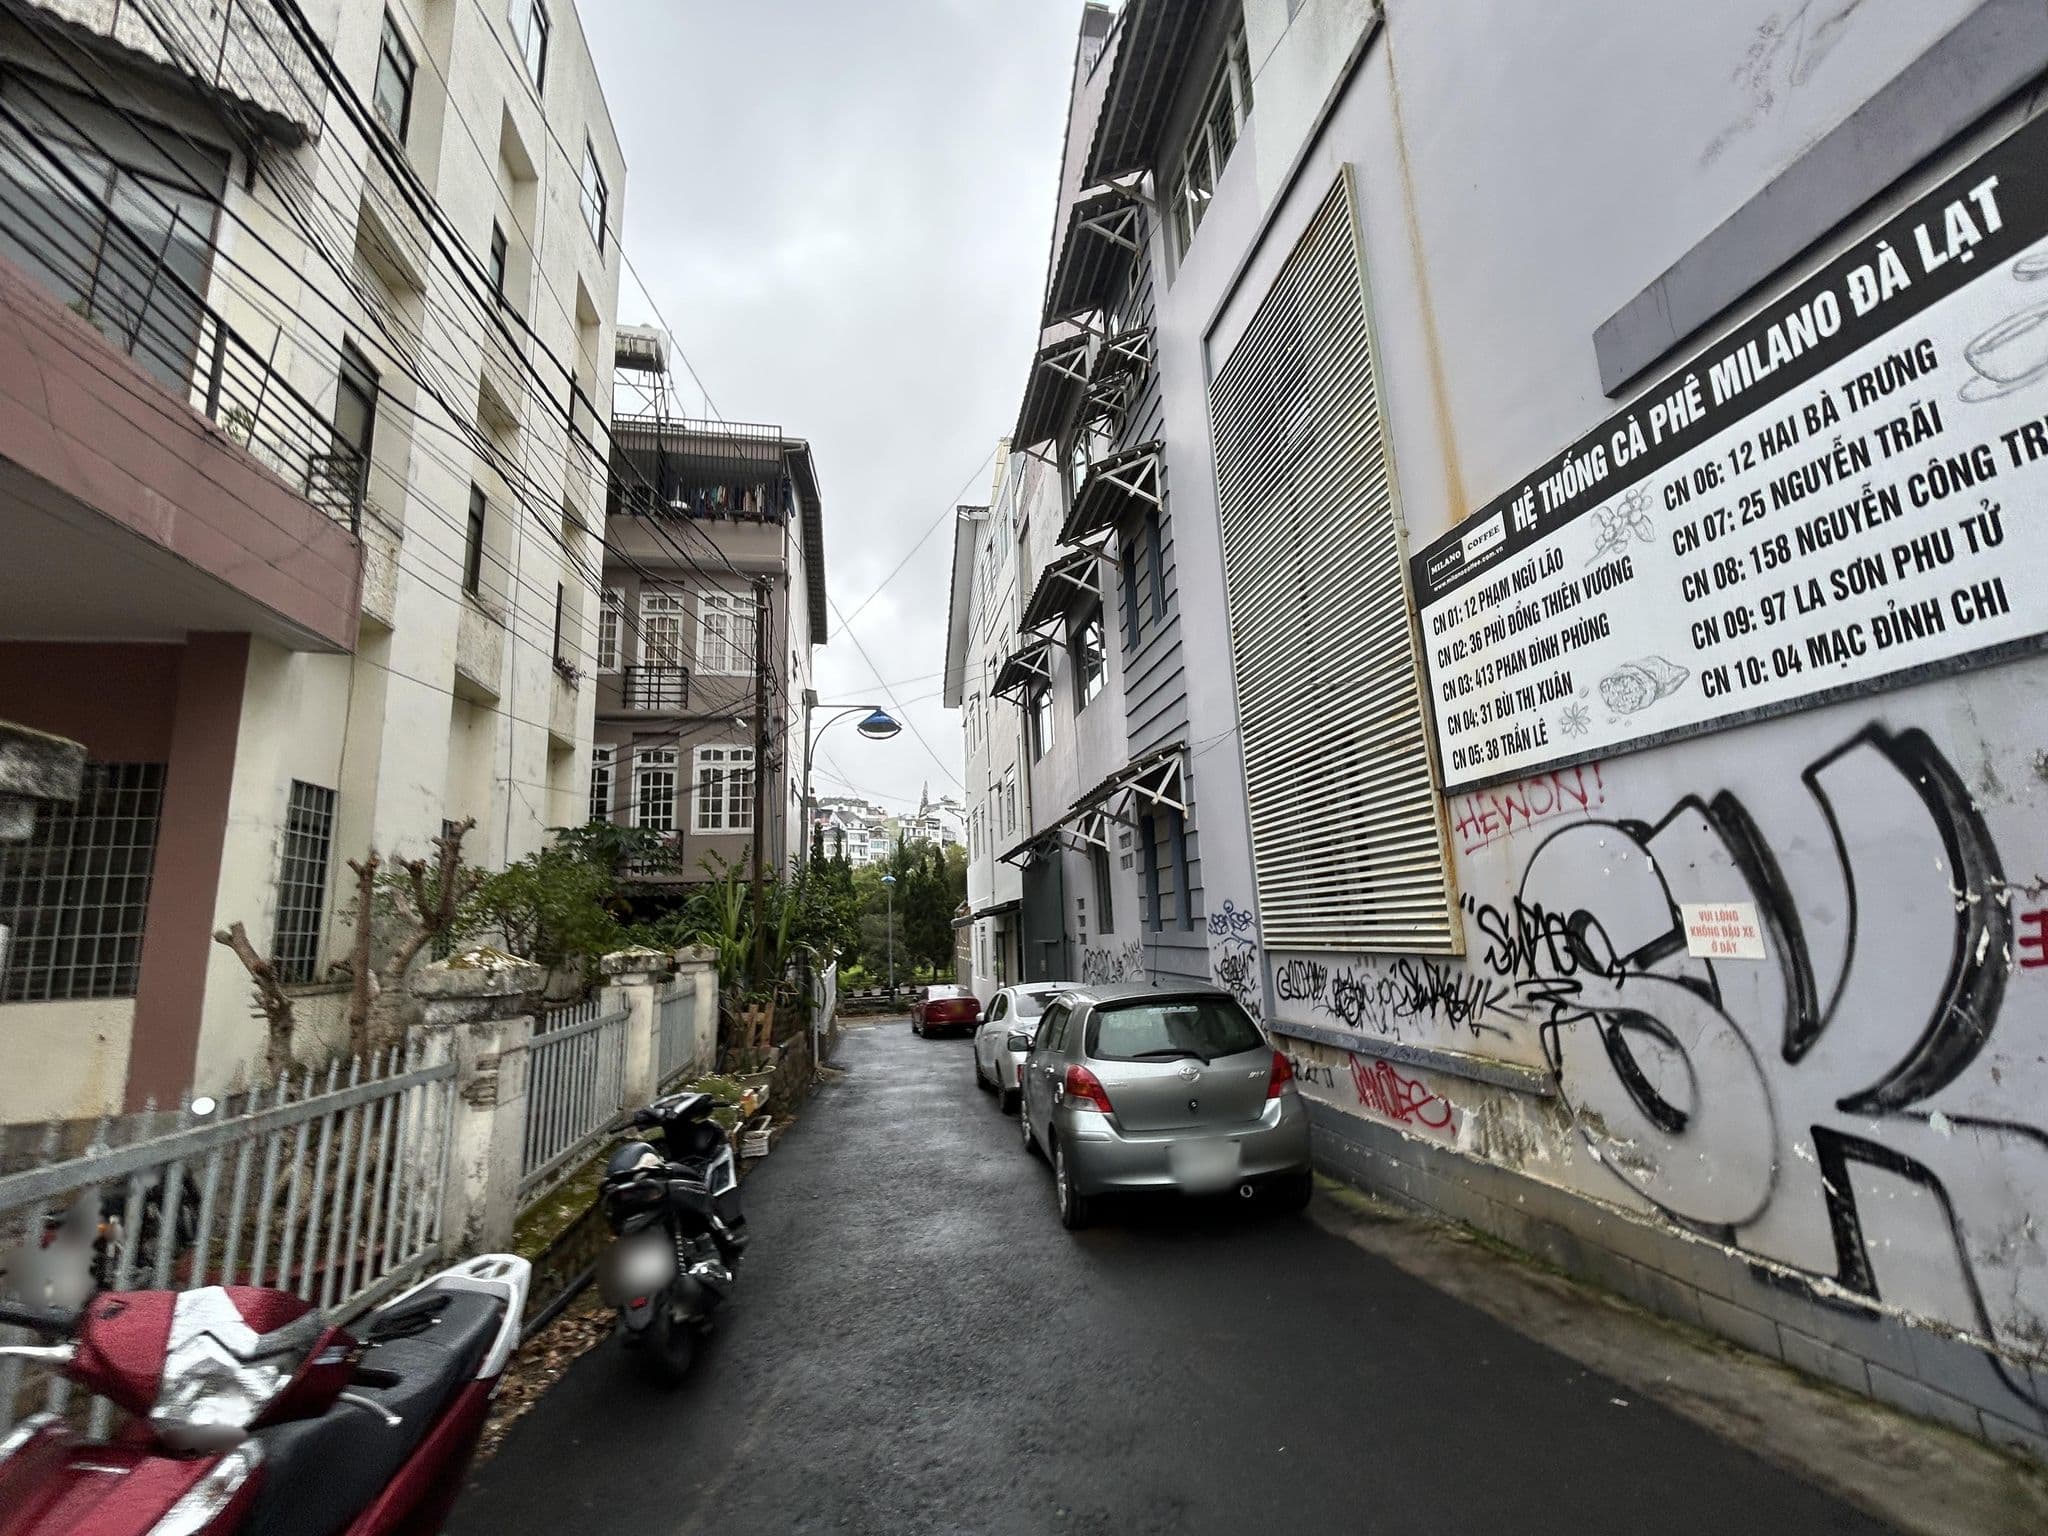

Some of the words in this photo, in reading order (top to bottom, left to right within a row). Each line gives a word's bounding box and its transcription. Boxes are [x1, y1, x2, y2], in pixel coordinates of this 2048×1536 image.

[1511, 486, 1538, 532] HỆ
[1539, 445, 1608, 512] THỐNG
[1611, 414, 1648, 467] CÀ
[1649, 373, 1707, 446] PHÊ
[1708, 290, 1842, 407] MILANO
[1848, 241, 1912, 317] ĐÀ
[1913, 175, 2003, 273] LẠT
[1663, 476, 1691, 511] CN
[1692, 460, 1725, 495] 06:
[1727, 440, 1756, 476] 12
[1758, 415, 1800, 460] HAI
[1802, 390, 1840, 436] BÀ
[1841, 338, 1939, 413] TRƯNG
[1672, 522, 1701, 556] CN
[1702, 507, 1736, 542] 07:
[1738, 489, 1766, 526] 25
[1770, 434, 1872, 511] NGUYỄN
[1874, 399, 1944, 458] TRÃI
[1681, 568, 1710, 603] CN
[1713, 556, 1746, 590] 08:
[1749, 533, 1792, 575] 158
[1795, 481, 1903, 557] NGUYỄN
[1907, 444, 1997, 509] CÔNG
[2000, 413, 2048, 468] TR
[1431, 550, 1461, 575] MILANO
[1467, 525, 1500, 550] COFFEE
[1433, 609, 1447, 636] CN
[1448, 607, 1464, 629] 01:
[1464, 596, 1478, 619] 12
[1478, 576, 1511, 612] PHẠM
[1512, 558, 1537, 594] NGŨ
[1540, 547, 1564, 579] LÃO
[1691, 616, 1721, 650] CN
[1723, 606, 1757, 639] 09:
[1760, 590, 1786, 626] 97
[1793, 578, 1827, 615] LA
[1829, 553, 1889, 601] SƠN
[1891, 527, 1955, 580] PHU
[1958, 498, 2004, 555] TỬ
[1437, 645, 1452, 669] CN
[1452, 639, 1469, 661] 02:
[1469, 630, 1483, 653] 36
[1483, 611, 1506, 647] PHÙ
[1508, 600, 1541, 636] ĐỔNG
[1541, 581, 1582, 619] THIÊN
[1583, 555, 1634, 599] VƯƠNG
[1442, 679, 1456, 702] CN
[1457, 673, 1474, 696] 03:
[1475, 663, 1495, 689] 413
[1496, 650, 1528, 681] PHAN
[1528, 632, 1560, 667] ĐÌNH
[1561, 612, 1611, 653] PHÙNG
[1701, 665, 1732, 698] CN
[1735, 656, 1769, 689] 10:
[1772, 644, 1802, 678] 04
[1806, 623, 1868, 669] MẠC
[1871, 599, 1946, 650] ĐỈNH
[1950, 577, 2010, 625] CHI
[1447, 714, 1462, 736] CN
[1463, 709, 1479, 731] 04:
[1480, 702, 1494, 724] 31
[1495, 691, 1516, 720] BÙI
[1516, 685, 1537, 713] THỊ
[1537, 671, 1574, 704] XUÂN
[1452, 748, 1467, 770] CN
[1468, 743, 1485, 764] 05:
[1485, 737, 1499, 760] 38
[1500, 722, 1532, 757] TRẦN
[1532, 718, 1549, 748] LÊ
[1690, 924, 1720, 937] KHÔNG
[1742, 926, 1755, 938] XE
[1699, 910, 1713, 921] VUI
